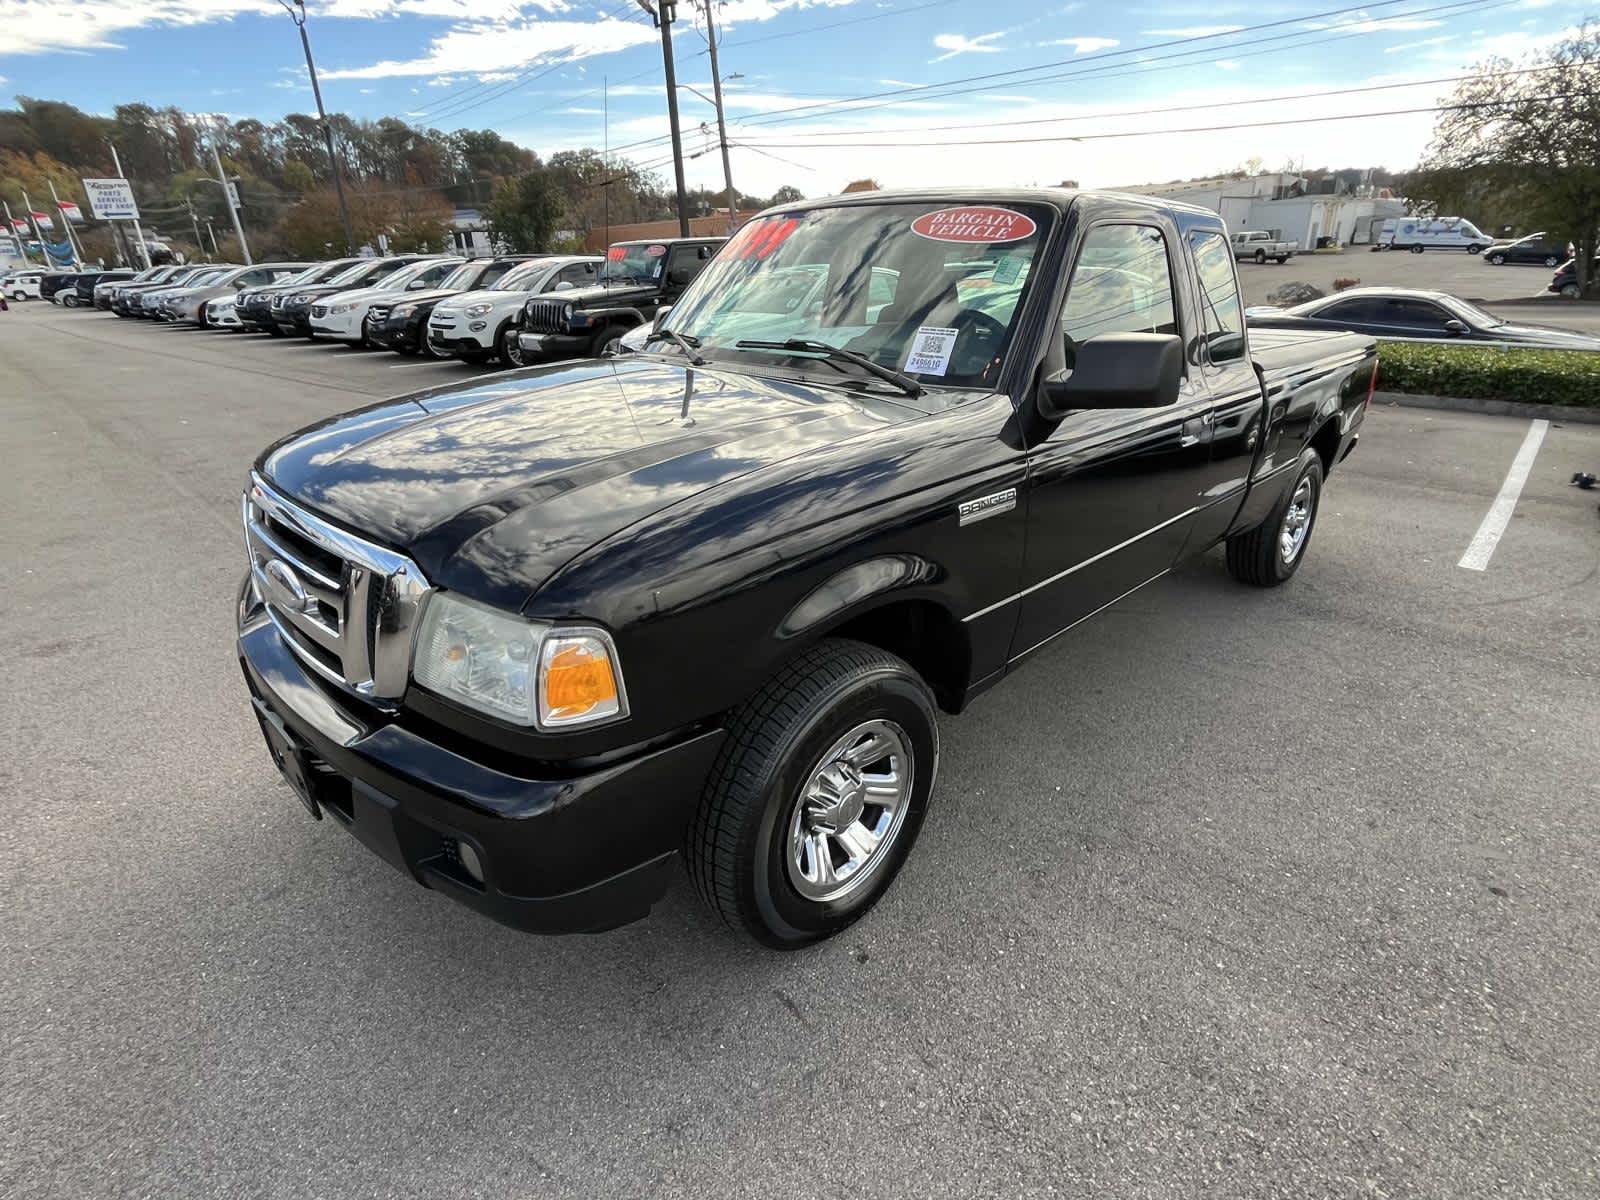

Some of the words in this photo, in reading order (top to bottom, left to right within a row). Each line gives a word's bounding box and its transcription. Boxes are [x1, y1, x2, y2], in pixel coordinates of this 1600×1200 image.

[931, 212, 1018, 227] BARGAIN
[928, 224, 1012, 239] VEHICLE
[960, 490, 1015, 517] RANGER
